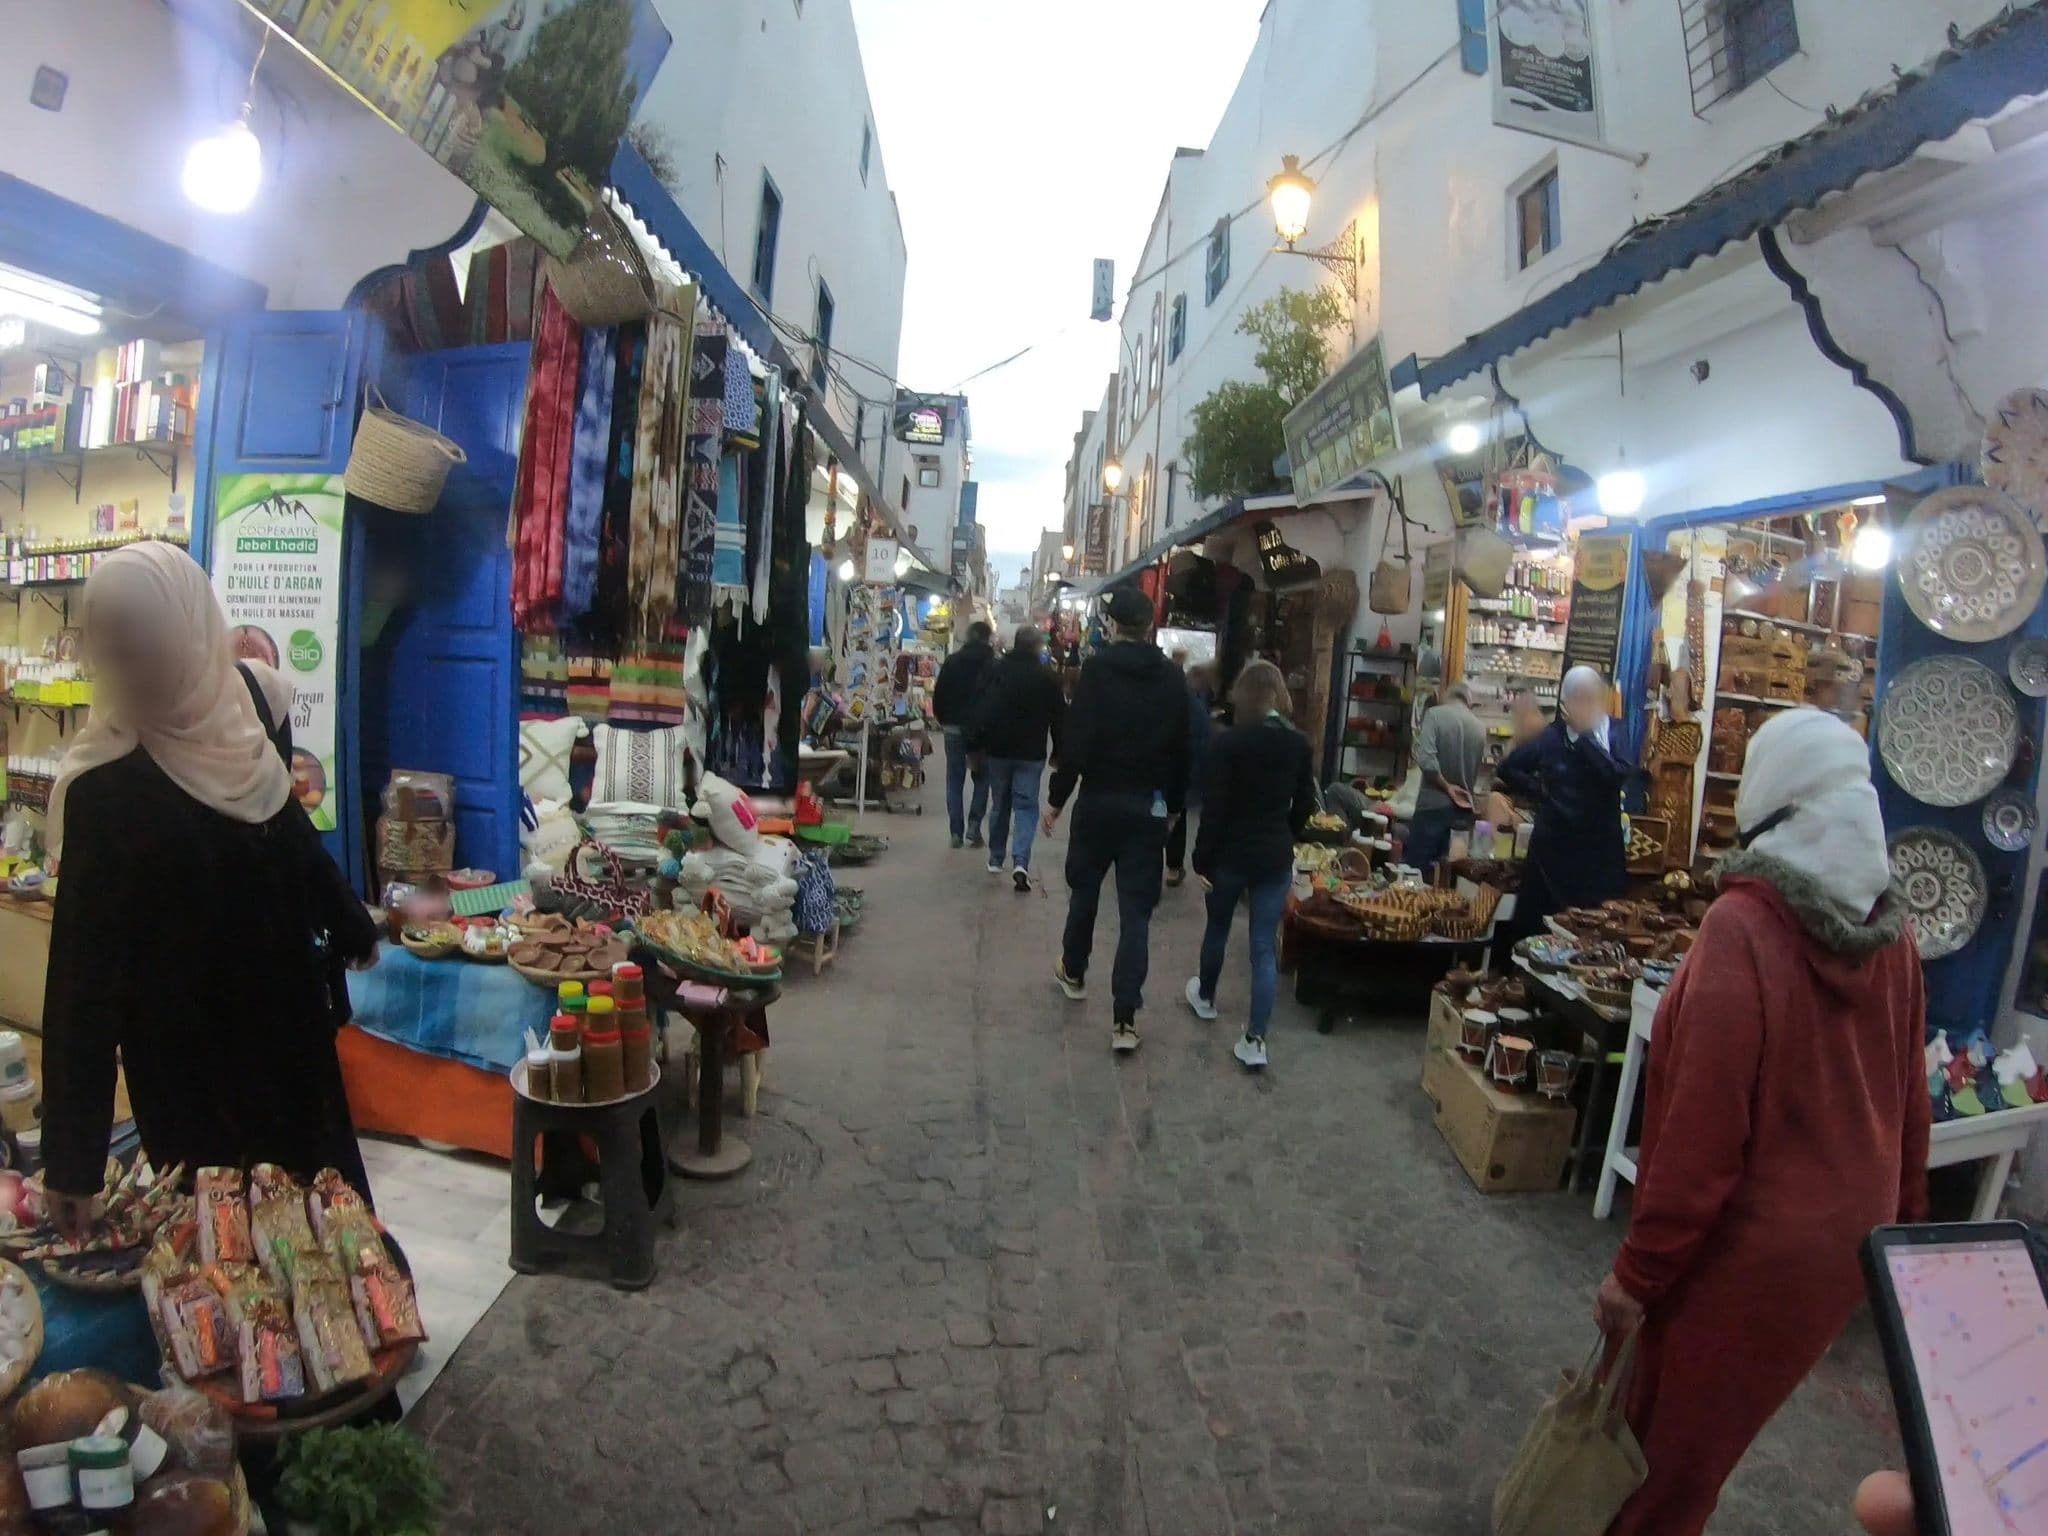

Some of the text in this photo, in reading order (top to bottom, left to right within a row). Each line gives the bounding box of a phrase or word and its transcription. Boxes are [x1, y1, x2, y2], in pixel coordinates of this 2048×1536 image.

[238, 539, 272, 551] Jebel
[873, 547, 889, 560] 10
[233, 562, 253, 572] POUR
[268, 563, 317, 573] PRODUCTION
[227, 575, 322, 591] D'HUILE D'ARGAN
[279, 608, 315, 619] MASSAGE
[291, 648, 320, 660] BIO
[294, 707, 312, 728] oil
